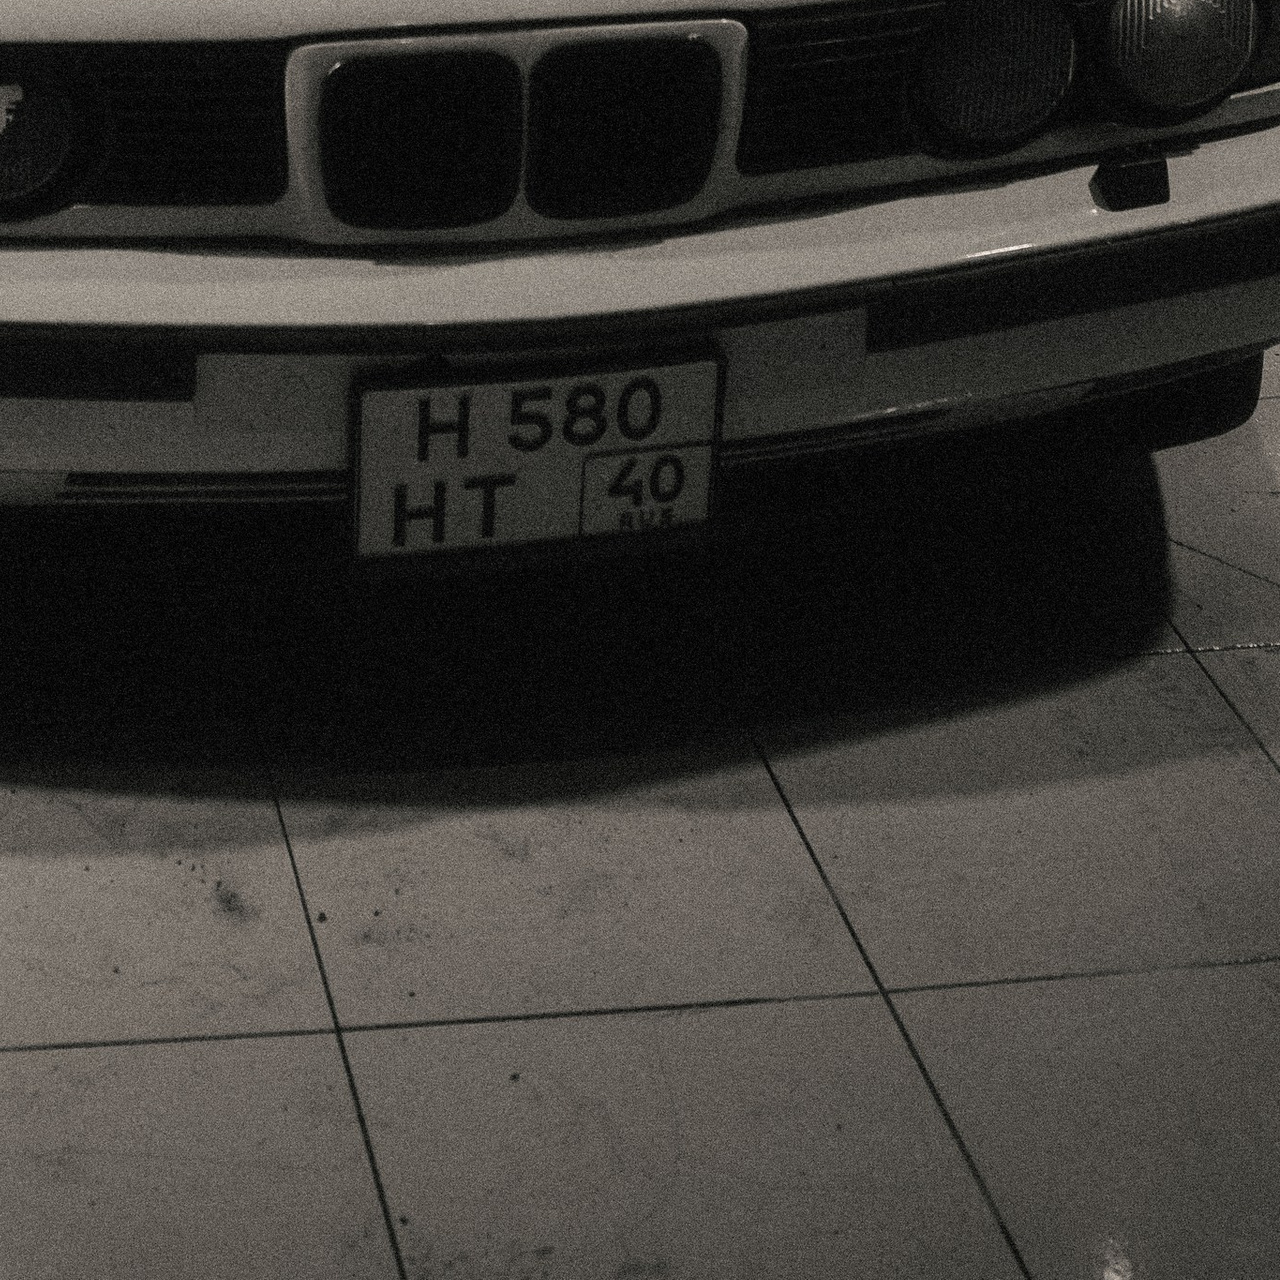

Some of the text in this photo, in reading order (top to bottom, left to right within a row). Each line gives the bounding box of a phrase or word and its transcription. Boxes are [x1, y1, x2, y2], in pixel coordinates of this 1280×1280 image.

[419, 375, 663, 462] H 580
[393, 473, 517, 547] HT
[608, 453, 686, 508] 40
